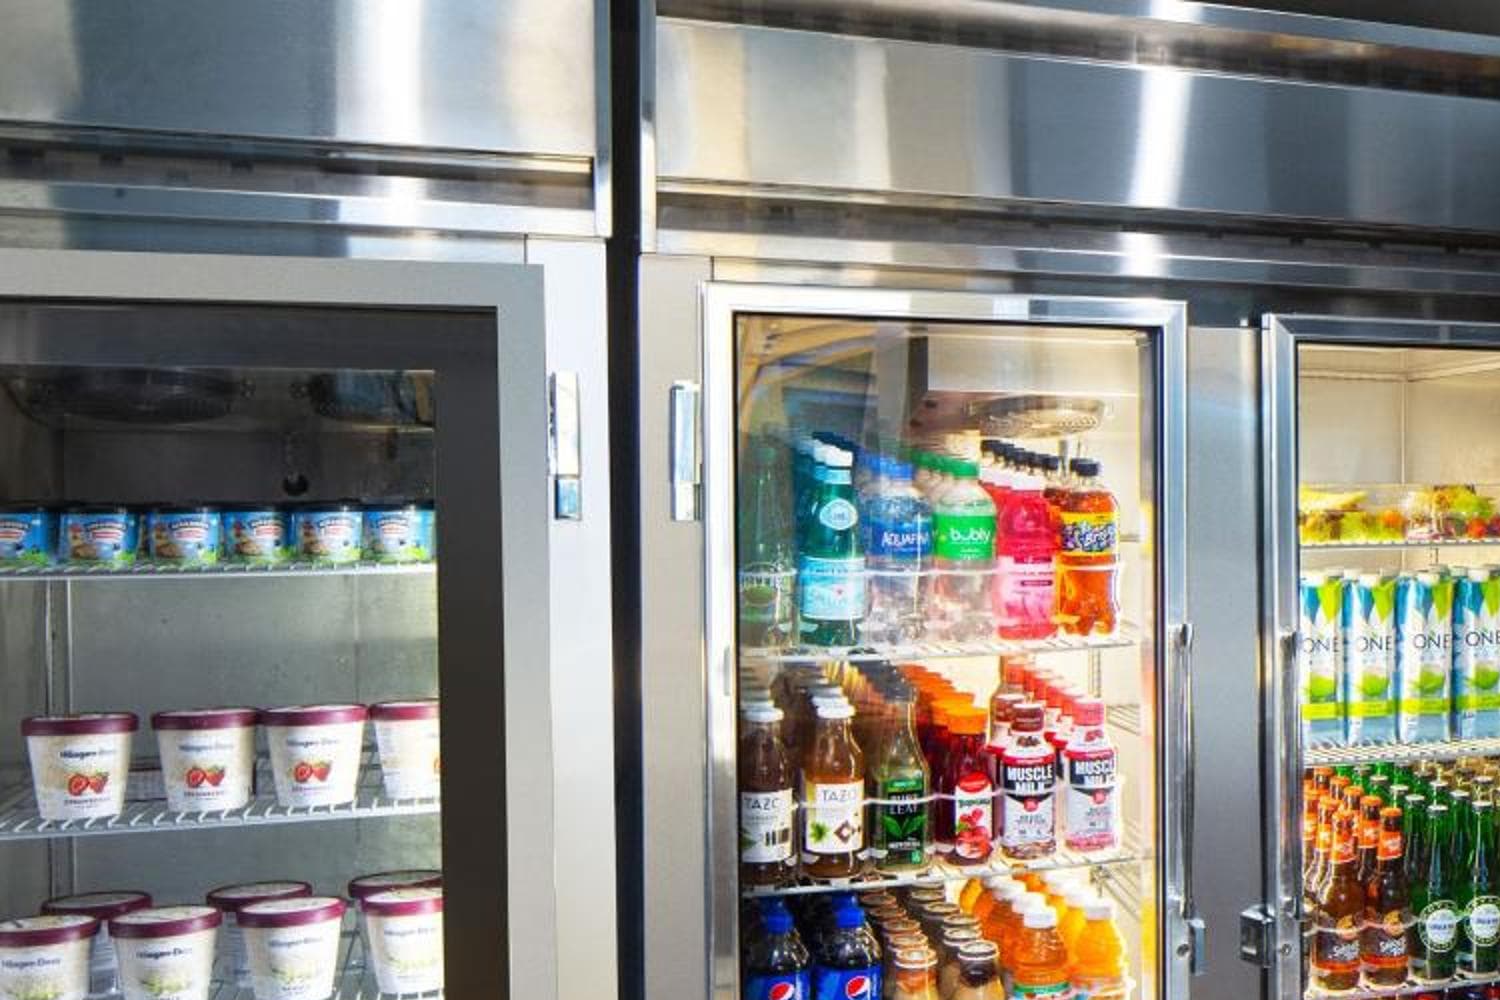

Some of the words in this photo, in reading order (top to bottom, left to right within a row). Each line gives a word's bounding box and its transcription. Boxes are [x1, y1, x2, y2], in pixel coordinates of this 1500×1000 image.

[950, 527, 991, 545] bubly
[1302, 634, 1339, 654] ONE
[1359, 633, 1393, 652] ONE
[1413, 631, 1451, 651] ONE
[1006, 765, 1052, 781] MUSCLE
[1015, 781, 1046, 795] MILK
